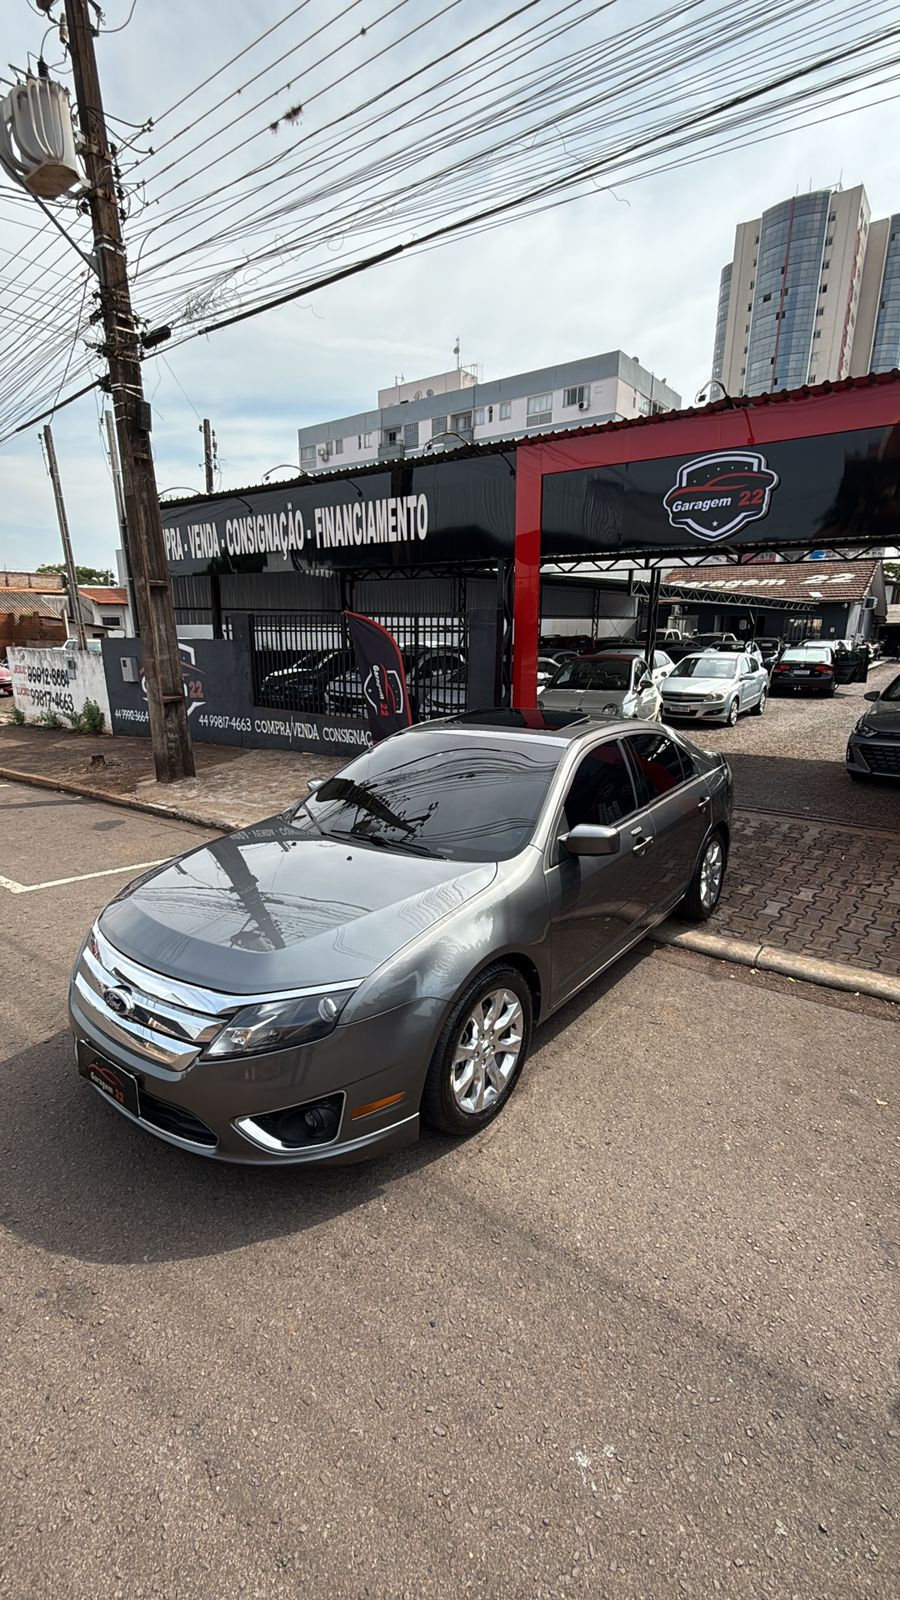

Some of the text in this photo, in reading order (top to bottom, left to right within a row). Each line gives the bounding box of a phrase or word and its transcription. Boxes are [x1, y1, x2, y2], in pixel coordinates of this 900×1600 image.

[672, 488, 764, 512] Garagem 22
[162, 527, 184, 561] PRA
[187, 522, 221, 560] VENDA
[225, 502, 304, 560] CONSIGNAÇÃO
[314, 493, 428, 549] FINANCIAMENTO
[800, 573, 856, 585] 22
[188, 681, 204, 698] 22
[198, 714, 208, 727] 44
[209, 715, 252, 731] 99817-4663
[323, 727, 374, 748] CONSIGNAÇ
[105, 992, 120, 1010] Ford
